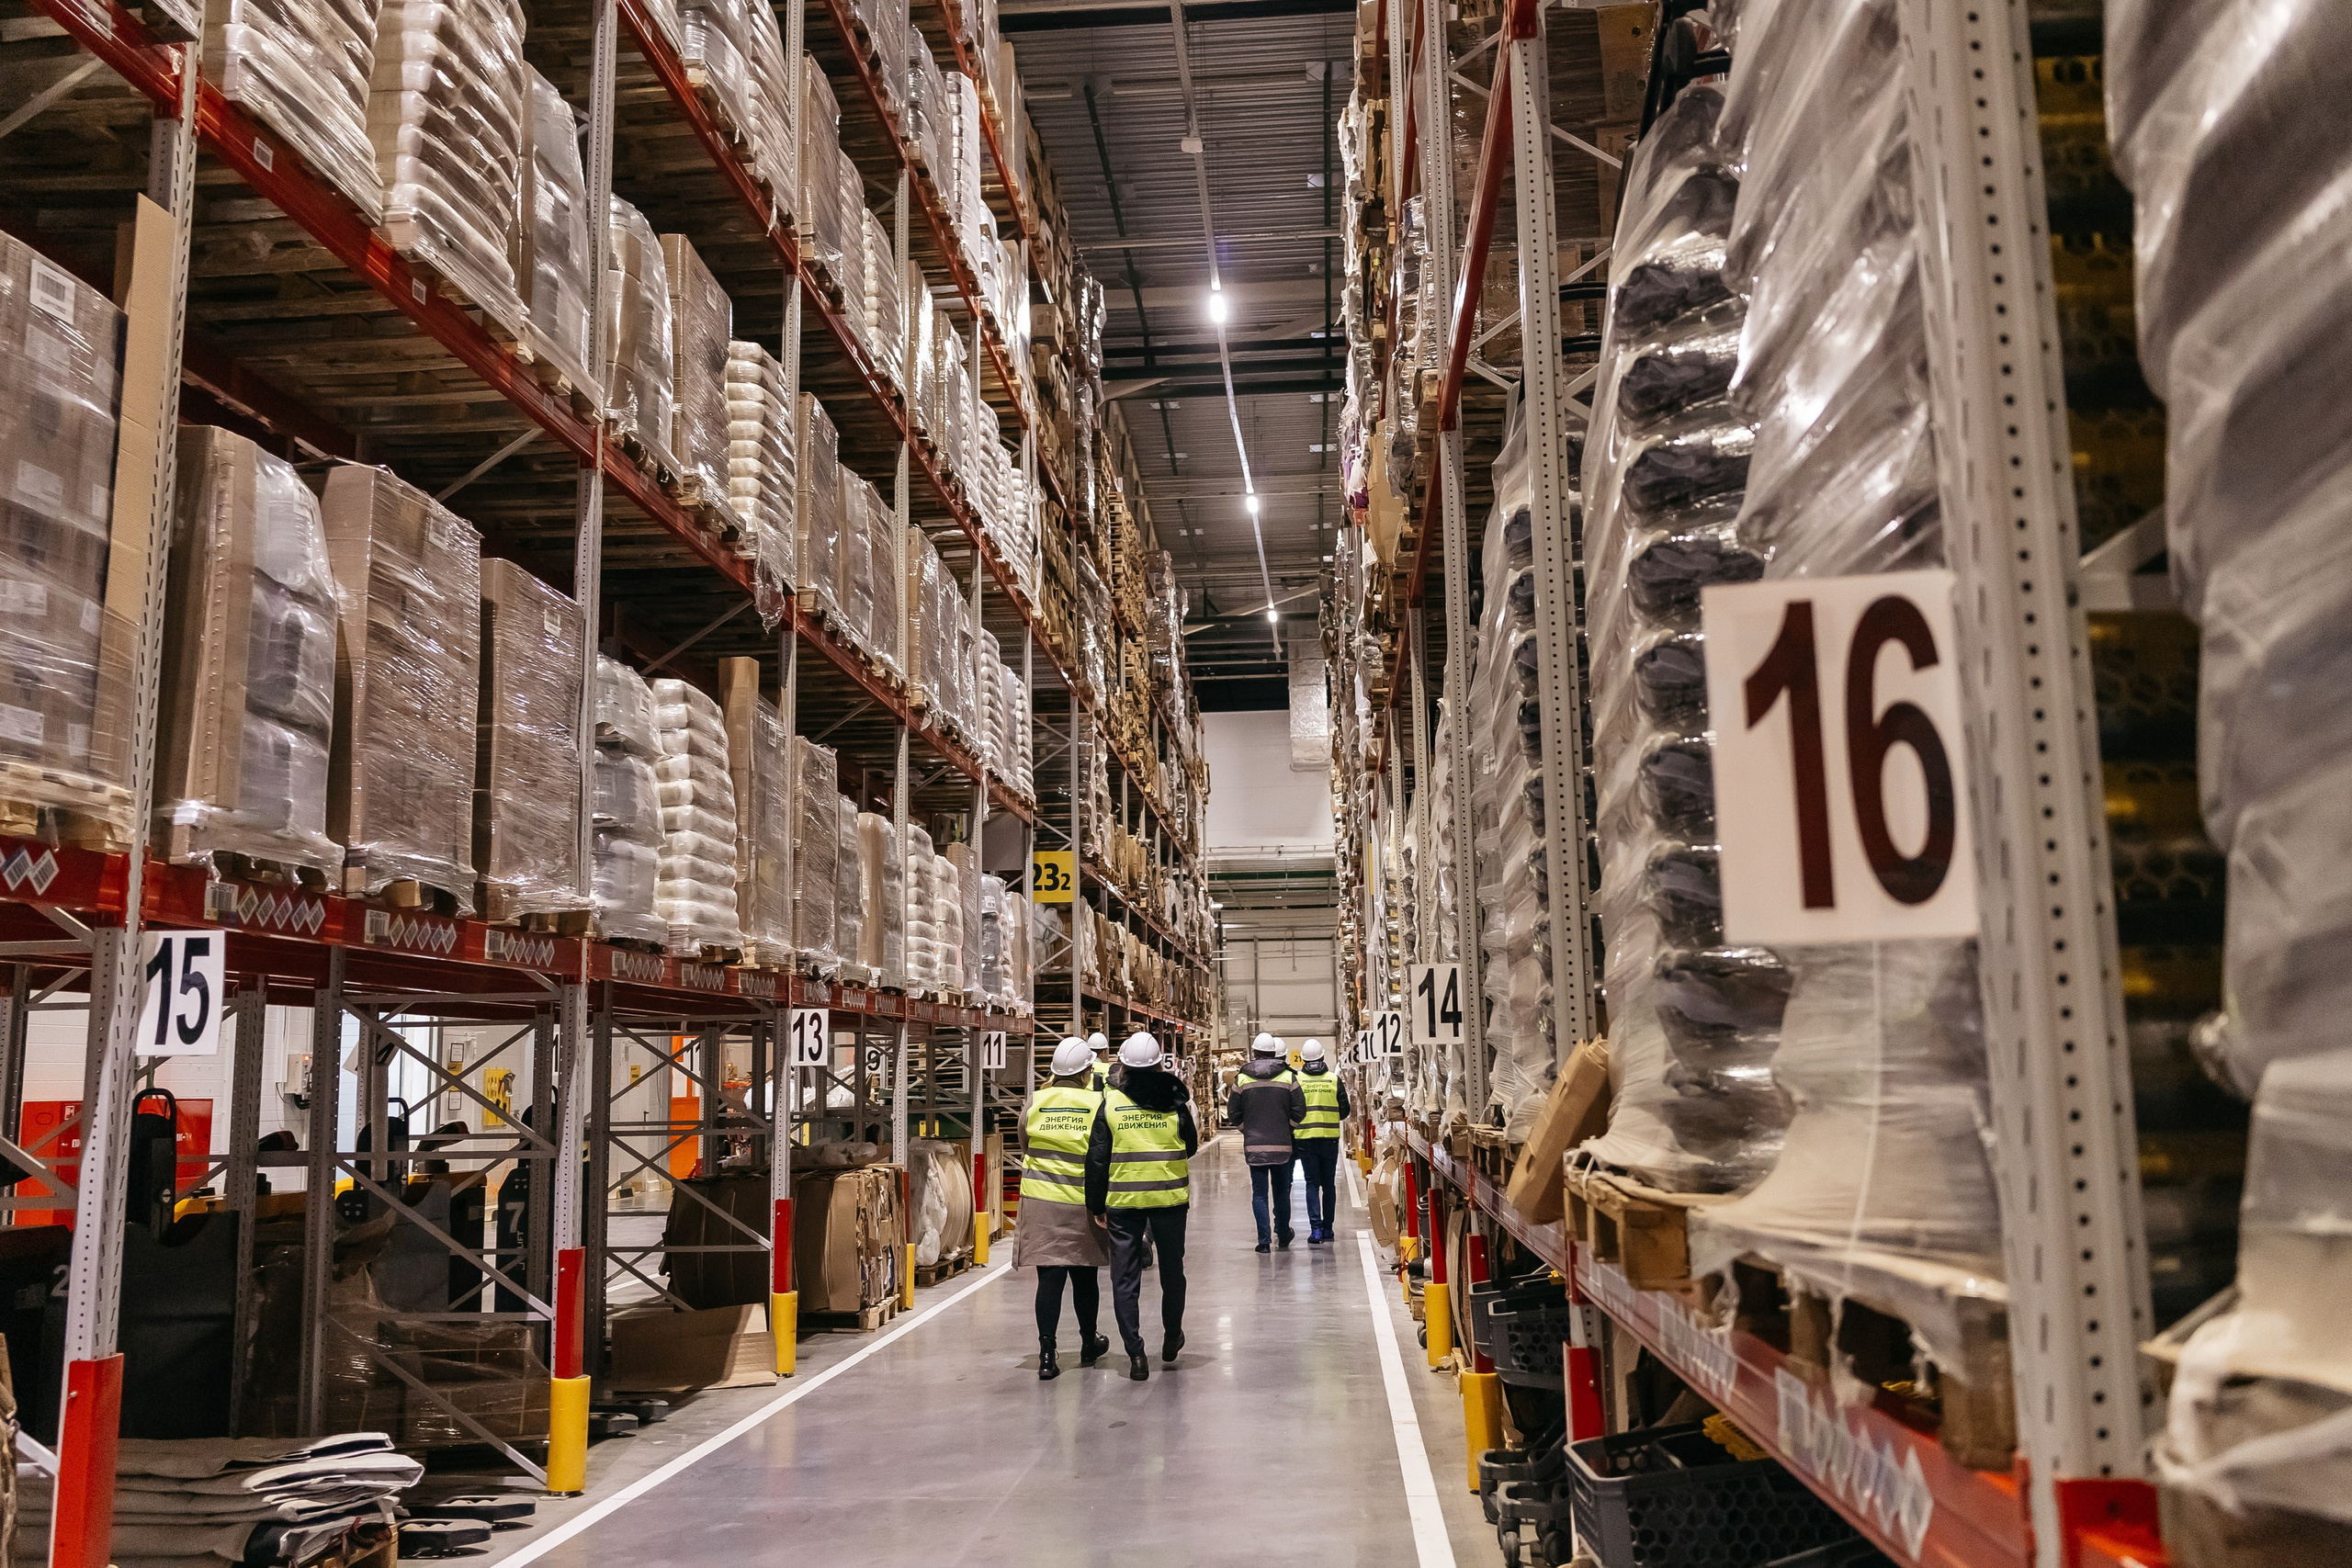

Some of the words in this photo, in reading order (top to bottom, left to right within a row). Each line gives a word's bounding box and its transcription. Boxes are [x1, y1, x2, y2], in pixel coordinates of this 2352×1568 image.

[1744, 592, 1957, 911] 16
[146, 937, 210, 1045] 15
[1418, 967, 1463, 1038] 14
[792, 1011, 823, 1062] 13
[983, 1033, 1002, 1066] 11
[1377, 1013, 1402, 1054] 12
[867, 1050, 881, 1072] 9
[1164, 1055, 1174, 1070] 5
[1039, 1123, 1088, 1132] ДВИЖЕНИЯ
[1045, 1115, 1084, 1123] ЭНЕРГИЯ
[1117, 1121, 1168, 1131] ДВИЖЕНИЯ
[1122, 1113, 1162, 1122] ЭНЕРГИЯ
[505, 1201, 526, 1234] 7
